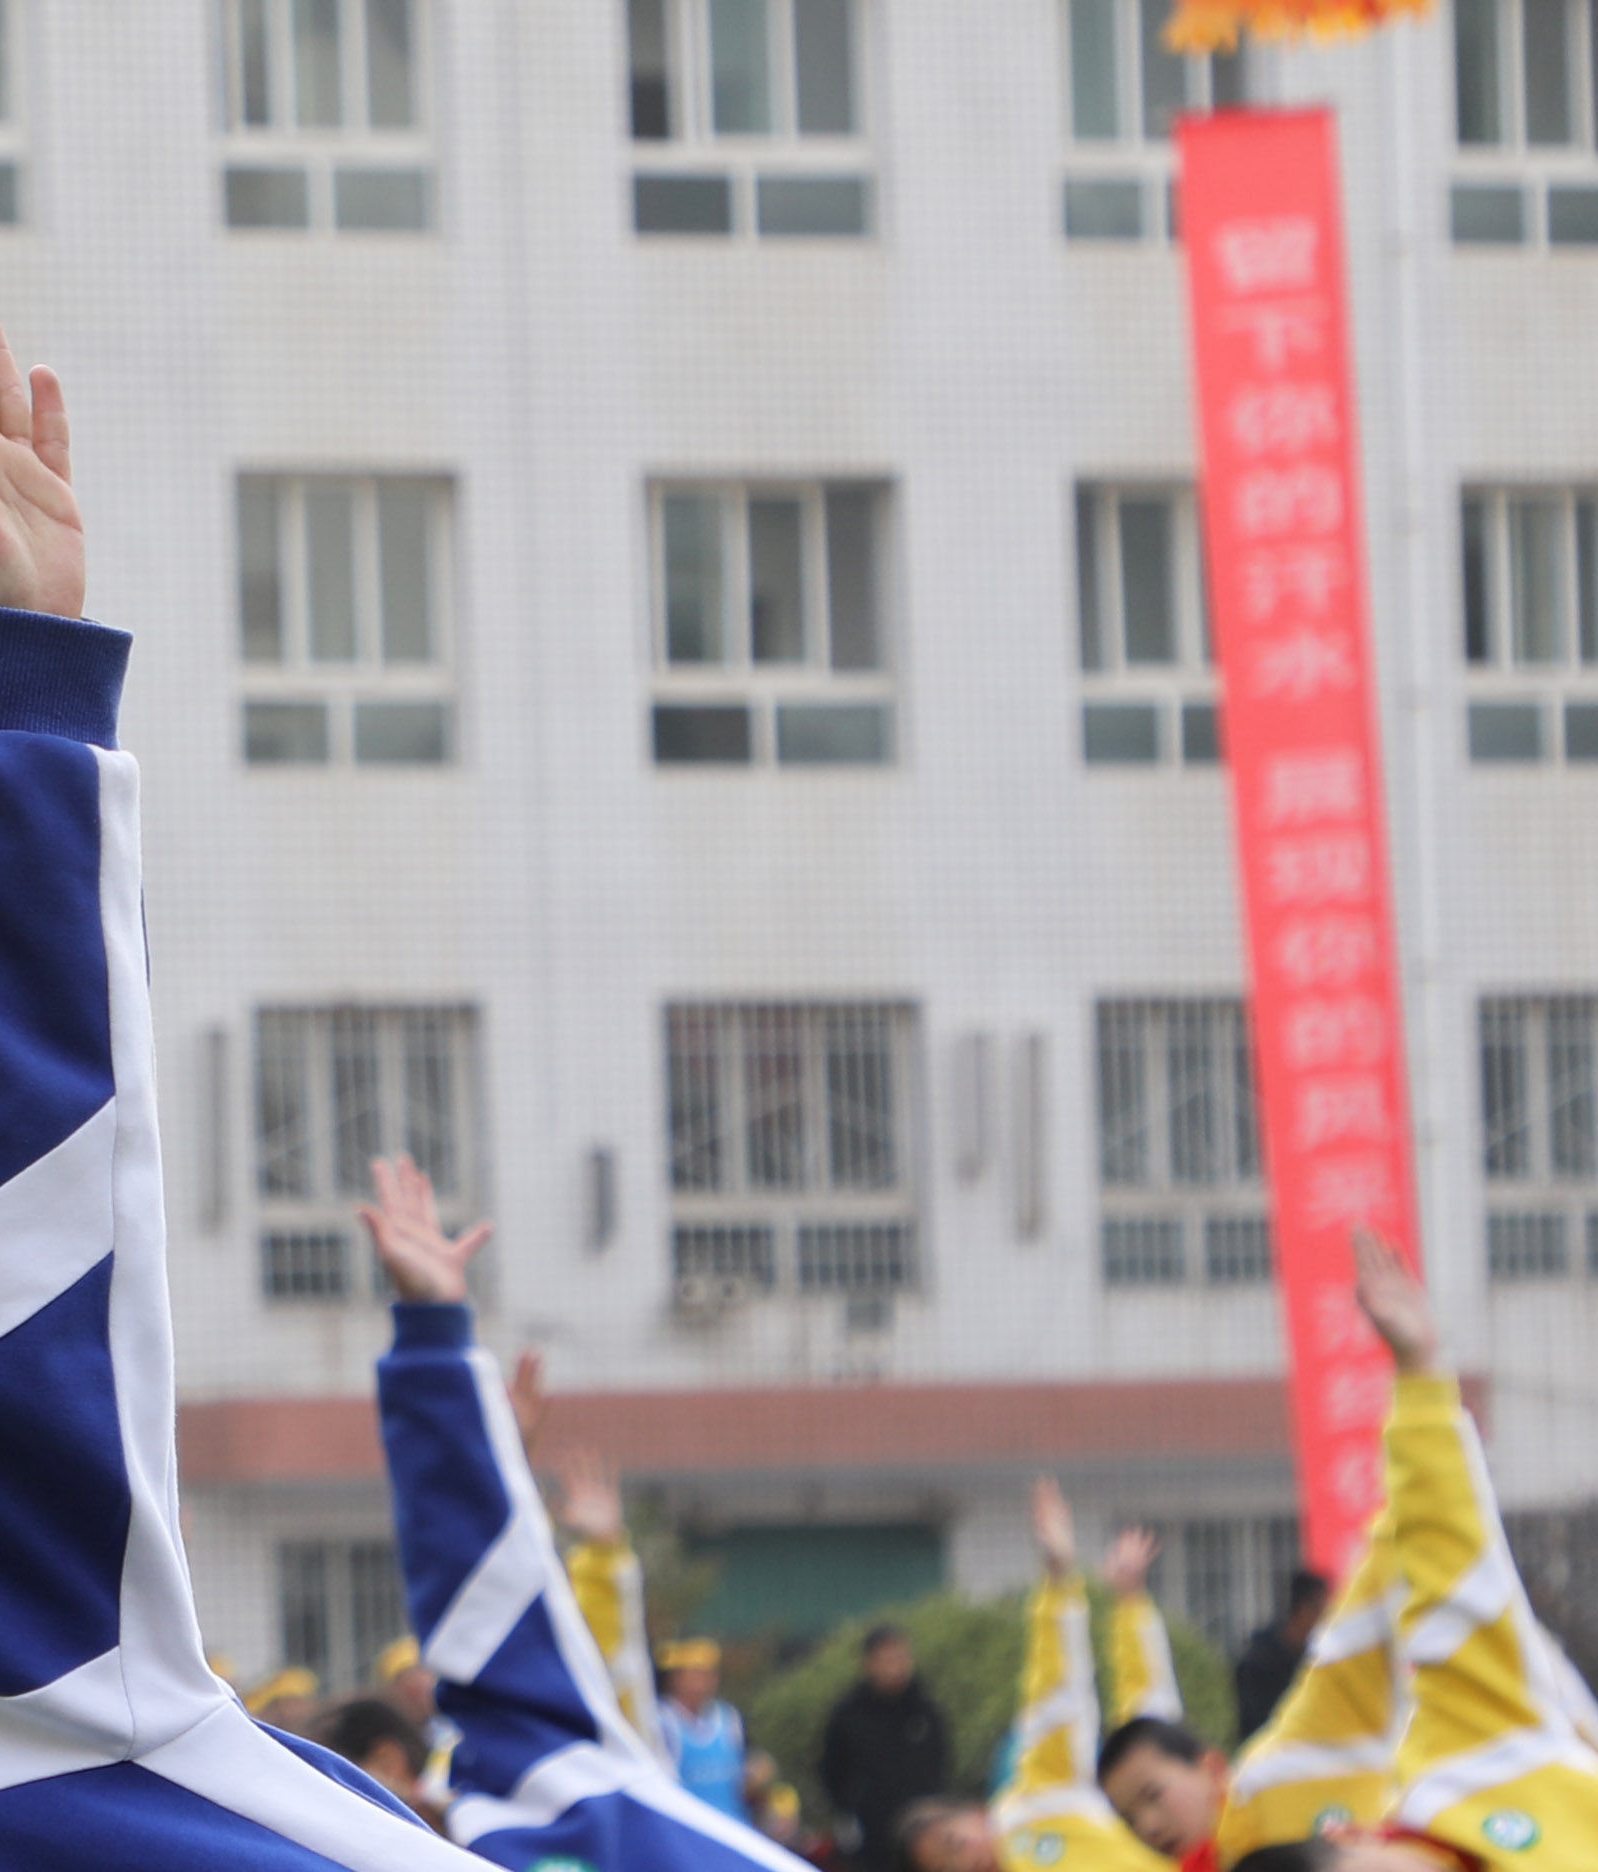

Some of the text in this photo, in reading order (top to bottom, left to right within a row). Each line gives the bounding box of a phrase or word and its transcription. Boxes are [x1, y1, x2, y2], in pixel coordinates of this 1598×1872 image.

[1214, 213, 1356, 705] 留下你的汗水
[1258, 748, 1394, 1233] 展现你的风采
